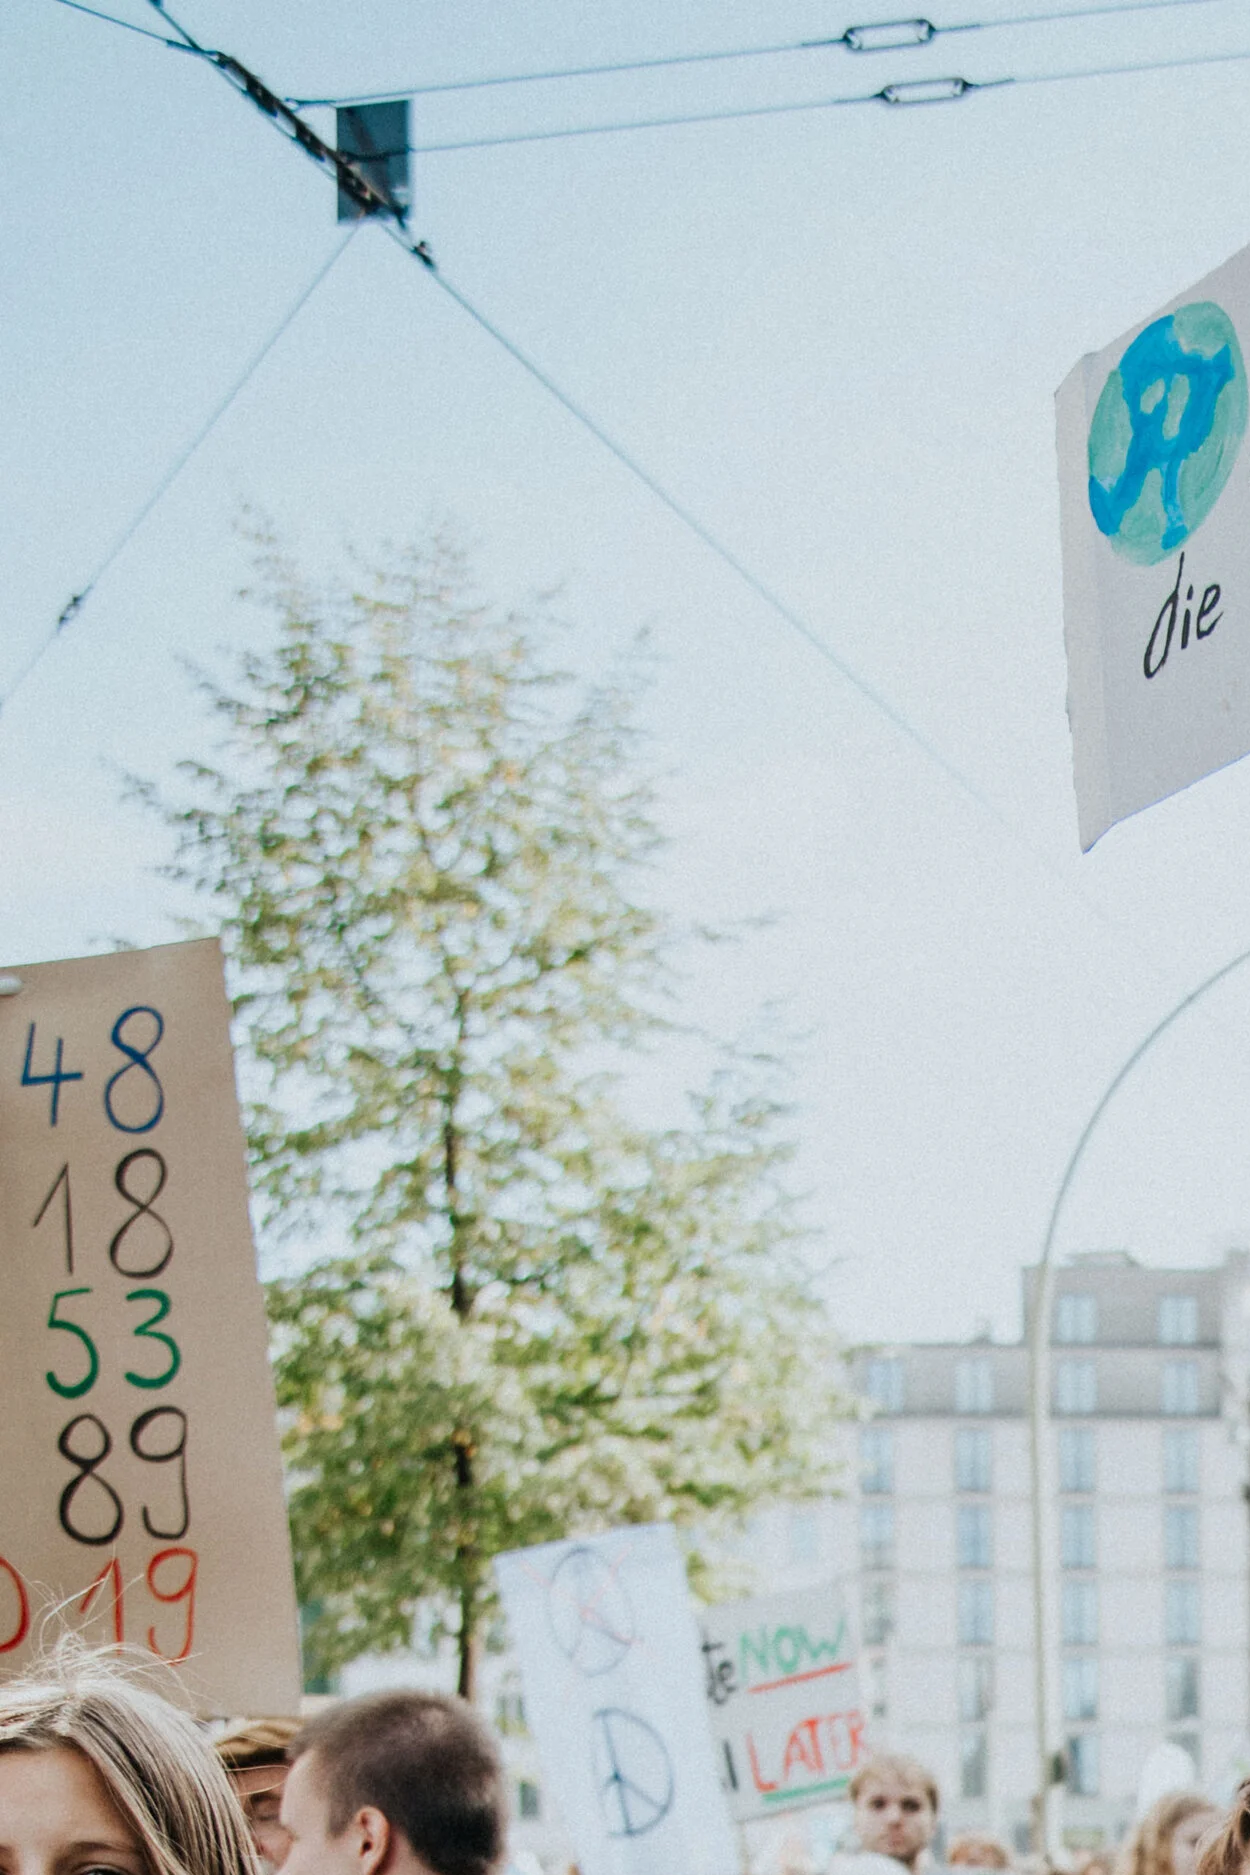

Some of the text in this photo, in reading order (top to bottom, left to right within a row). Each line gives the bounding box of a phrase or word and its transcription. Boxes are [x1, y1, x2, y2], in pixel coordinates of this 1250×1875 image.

[1143, 551, 1223, 679] die
[19, 1005, 164, 1135] 48
[33, 1147, 174, 1280] 18
[44, 1287, 182, 1400] 53
[56, 1405, 190, 1548] 89
[738, 1615, 847, 1684] NOW
[745, 1708, 870, 1793] LATER
